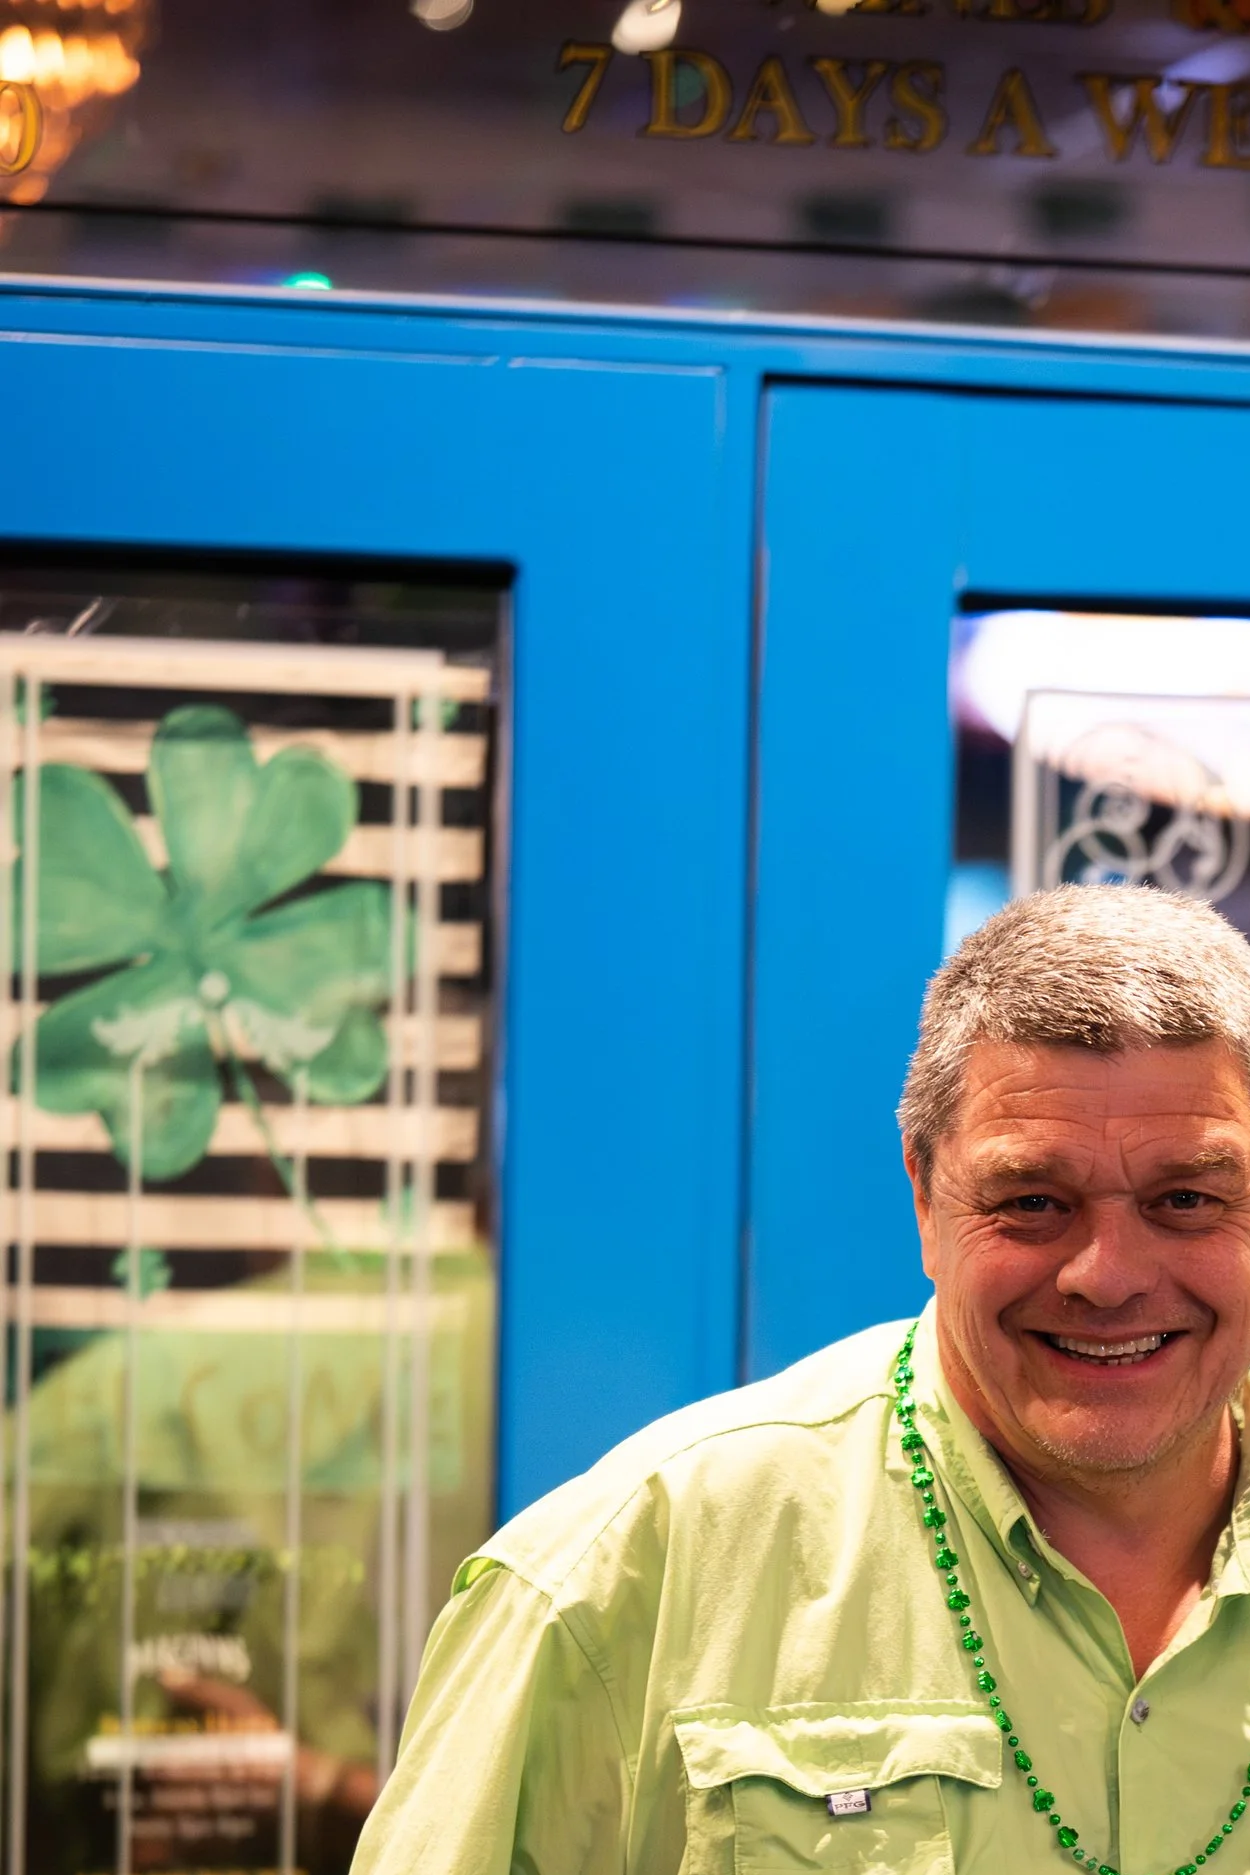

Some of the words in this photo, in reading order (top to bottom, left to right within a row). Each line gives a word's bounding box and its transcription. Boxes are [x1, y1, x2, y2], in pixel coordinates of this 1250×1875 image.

[556, 40, 613, 134] 7
[640, 49, 945, 151] DAYS
[966, 66, 1060, 158] A
[834, 1801, 866, 1810] PFG
